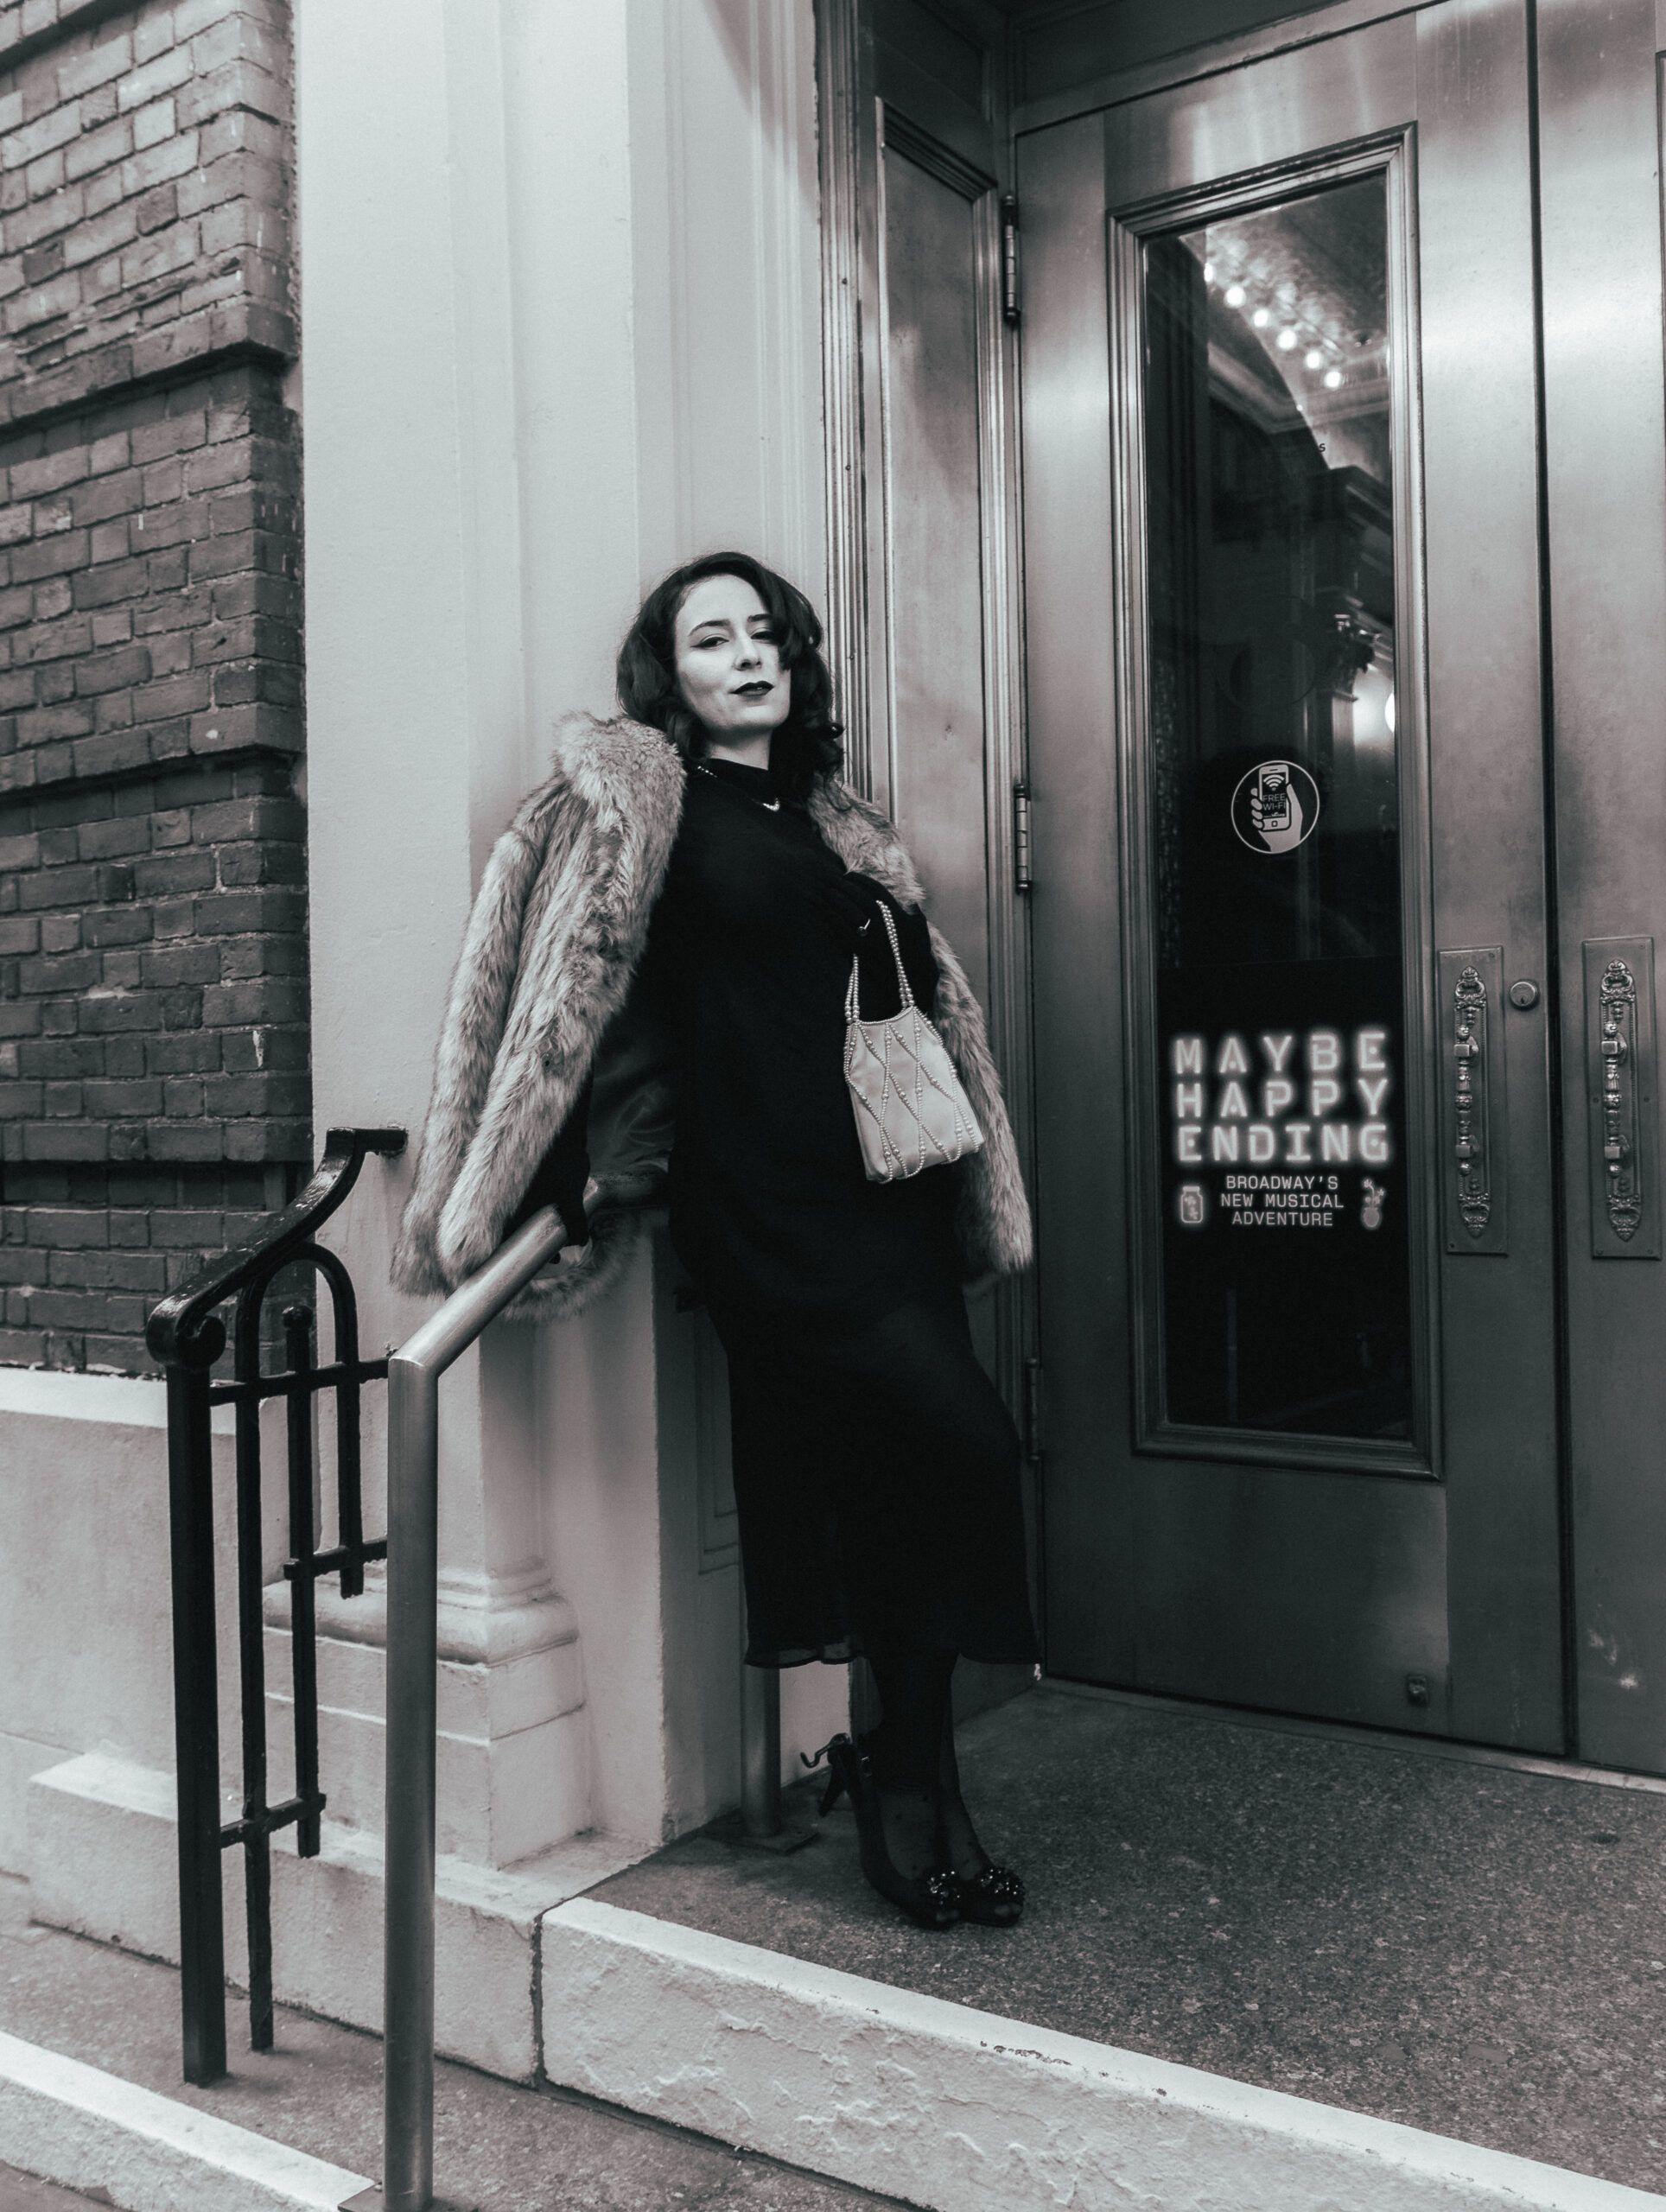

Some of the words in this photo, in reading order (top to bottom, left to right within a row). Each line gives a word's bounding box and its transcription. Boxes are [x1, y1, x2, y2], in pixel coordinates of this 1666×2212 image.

[1262, 793, 1286, 802] FREE
[1262, 801, 1286, 810] WI-FI
[1175, 1032, 1386, 1074] MAYBE
[1176, 1078, 1388, 1118] HAPPY
[1177, 1124, 1388, 1162] ENDING
[1226, 1175, 1339, 1190] BROADWAY'S
[1221, 1193, 1254, 1208] NEW
[1265, 1194, 1344, 1208] MUSICAL
[1232, 1211, 1333, 1227] ADVENTURE
